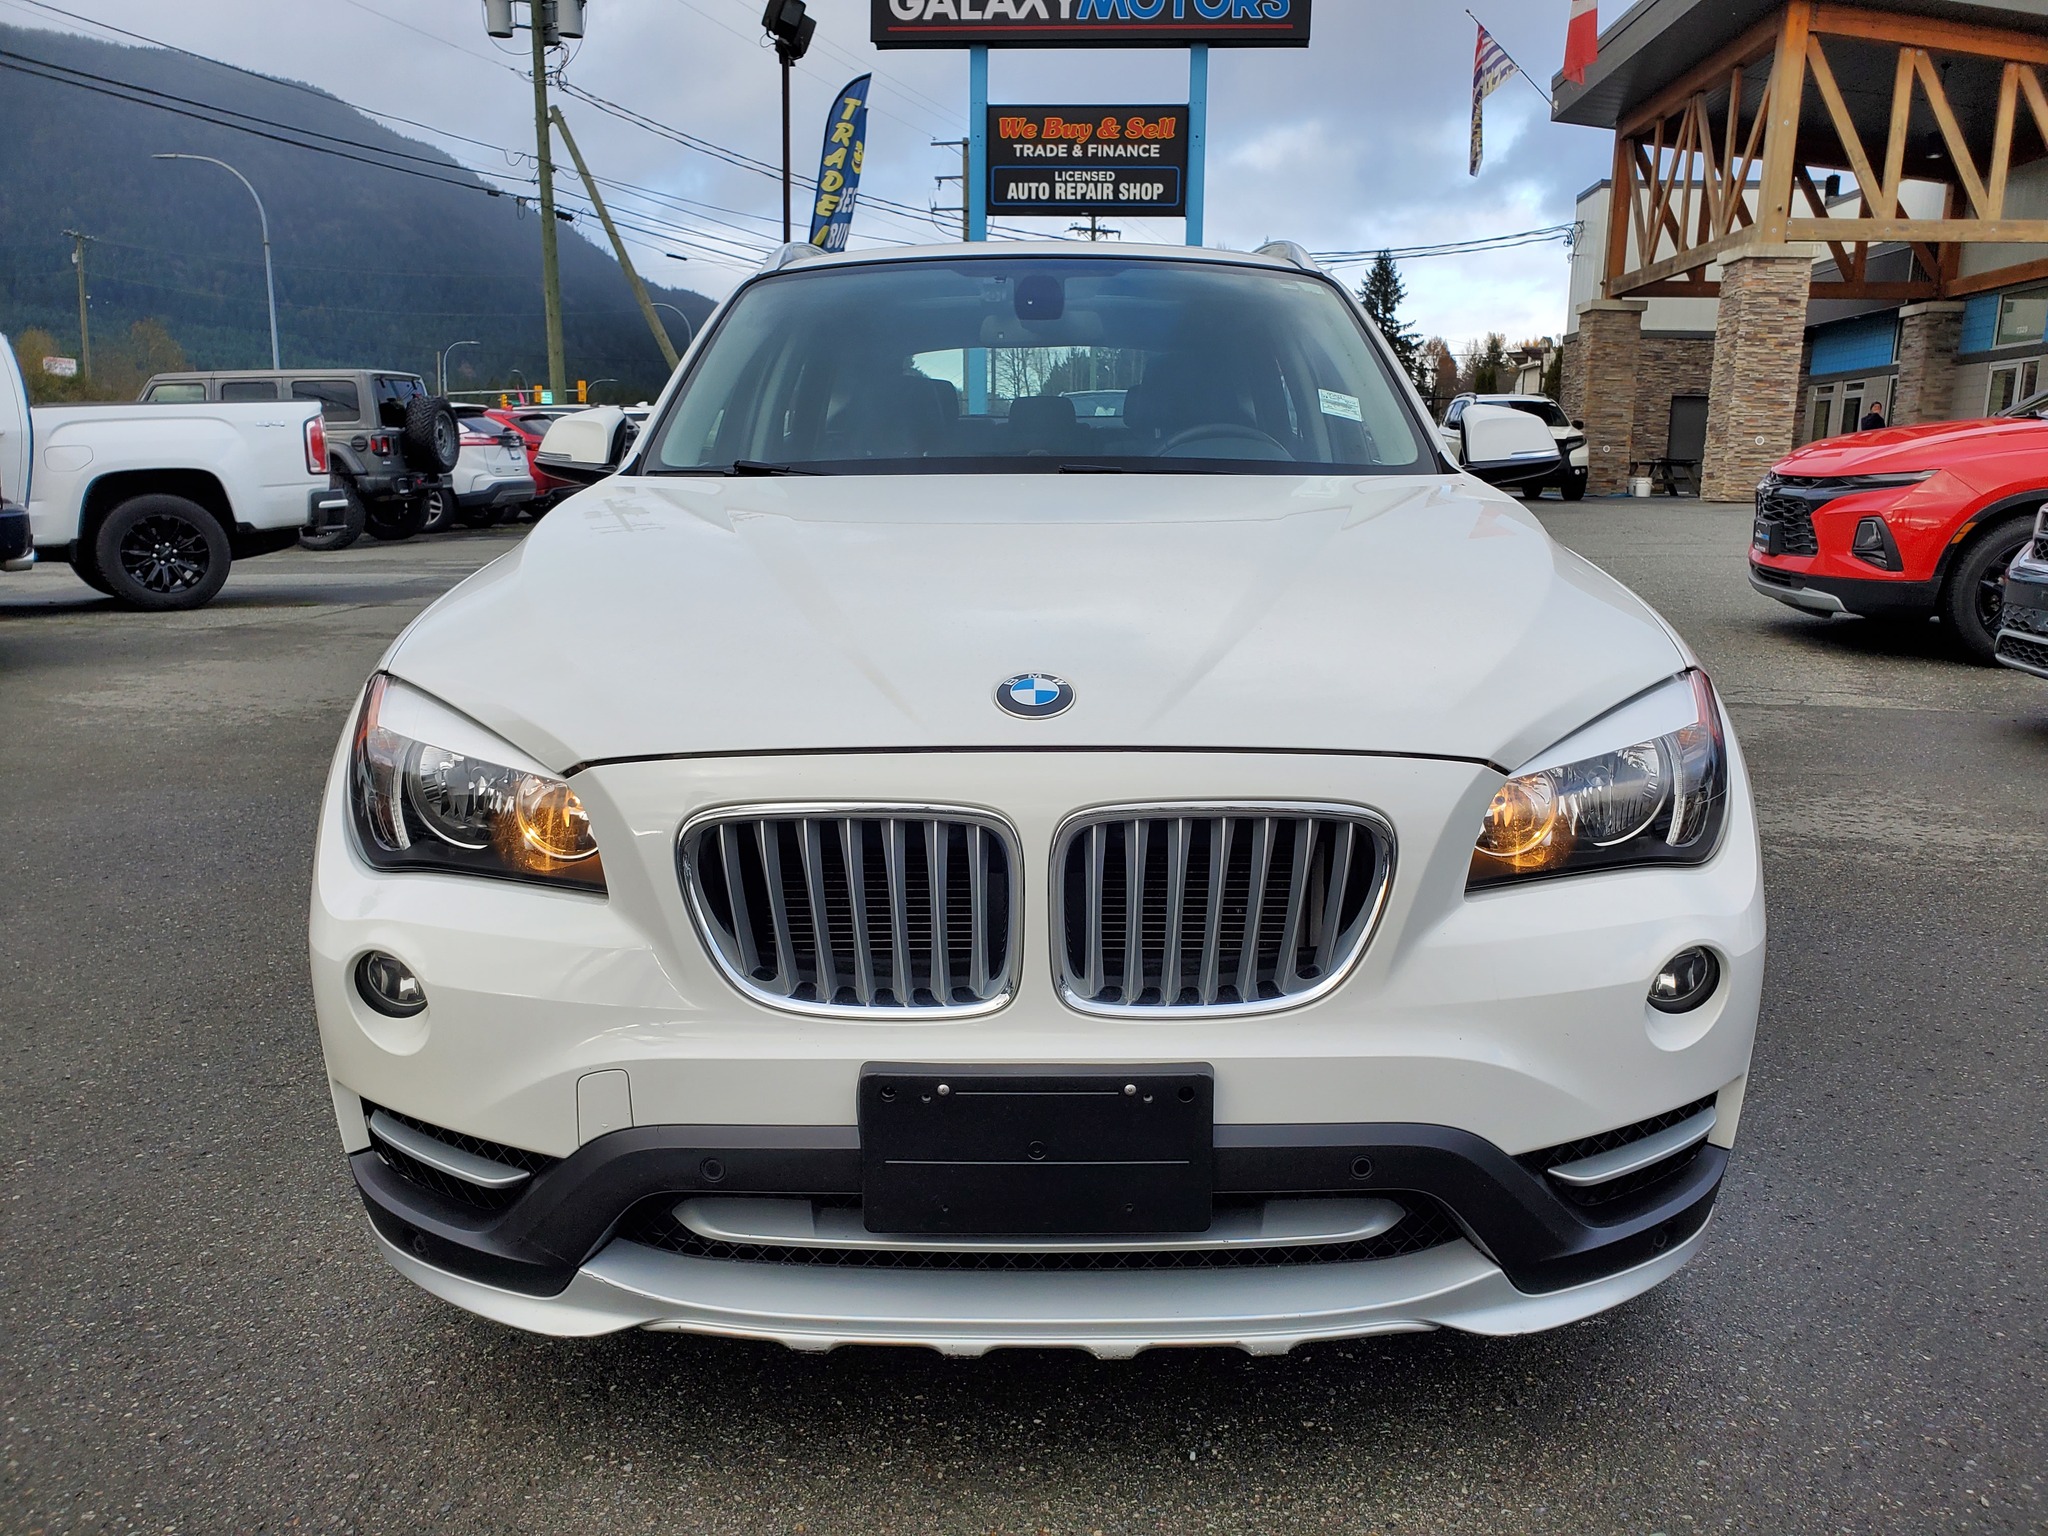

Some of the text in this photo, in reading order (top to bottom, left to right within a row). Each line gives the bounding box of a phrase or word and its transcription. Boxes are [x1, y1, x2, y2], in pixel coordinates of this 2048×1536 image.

[999, 117, 1176, 144] We Buy & Sell
[816, 97, 862, 217] TRADE
[1013, 144, 1161, 158] TRADE & FINANCE
[1054, 171, 1116, 182] LICENSED
[1007, 182, 1164, 201] AUTO REPAIR SHOP
[1004, 673, 1068, 686] BMW
